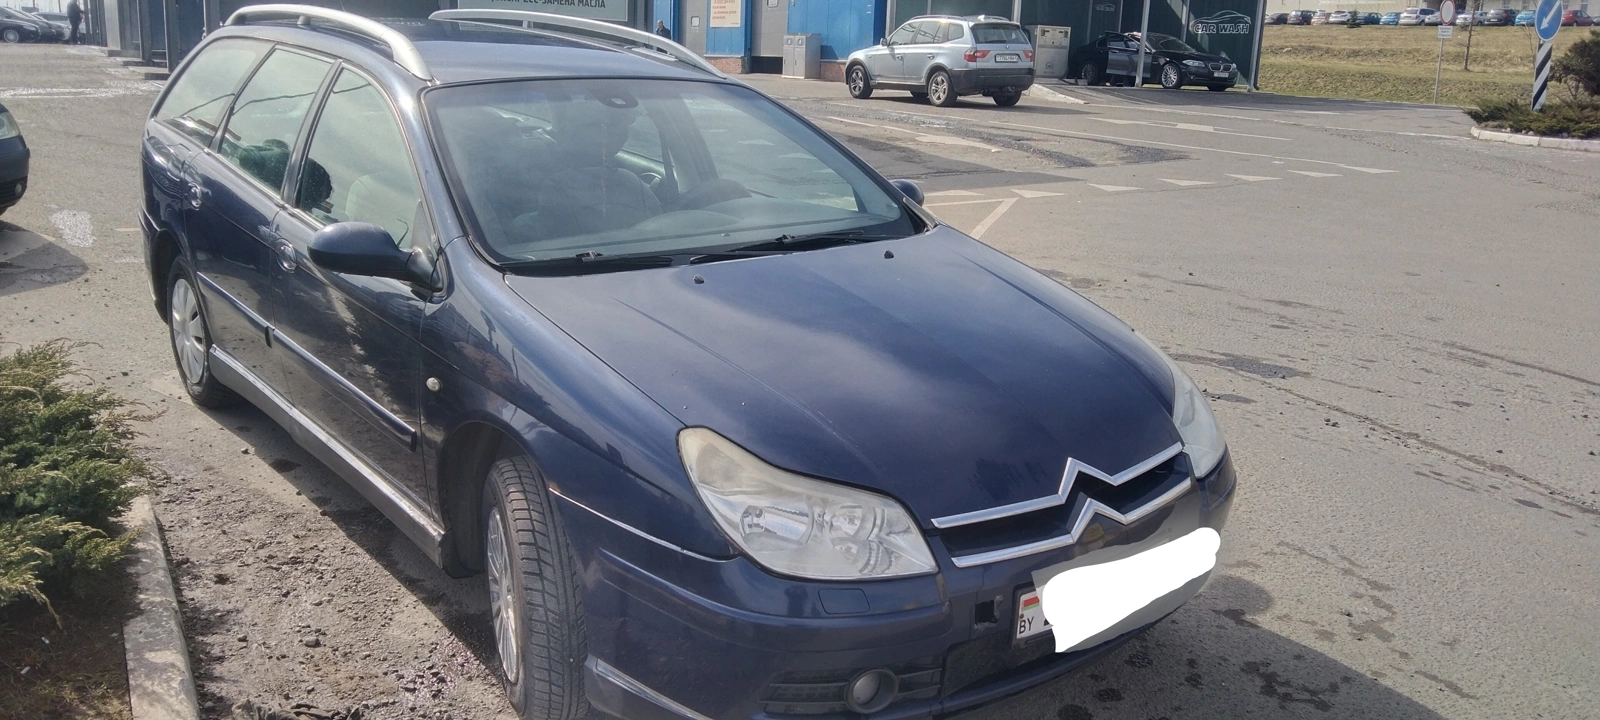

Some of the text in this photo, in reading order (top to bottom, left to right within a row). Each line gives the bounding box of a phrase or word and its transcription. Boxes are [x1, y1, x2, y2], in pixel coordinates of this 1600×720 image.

[577, 0, 605, 8] МАСЛА
[1193, 23, 1250, 34] CAR WASH
[1019, 616, 1034, 634] BY
